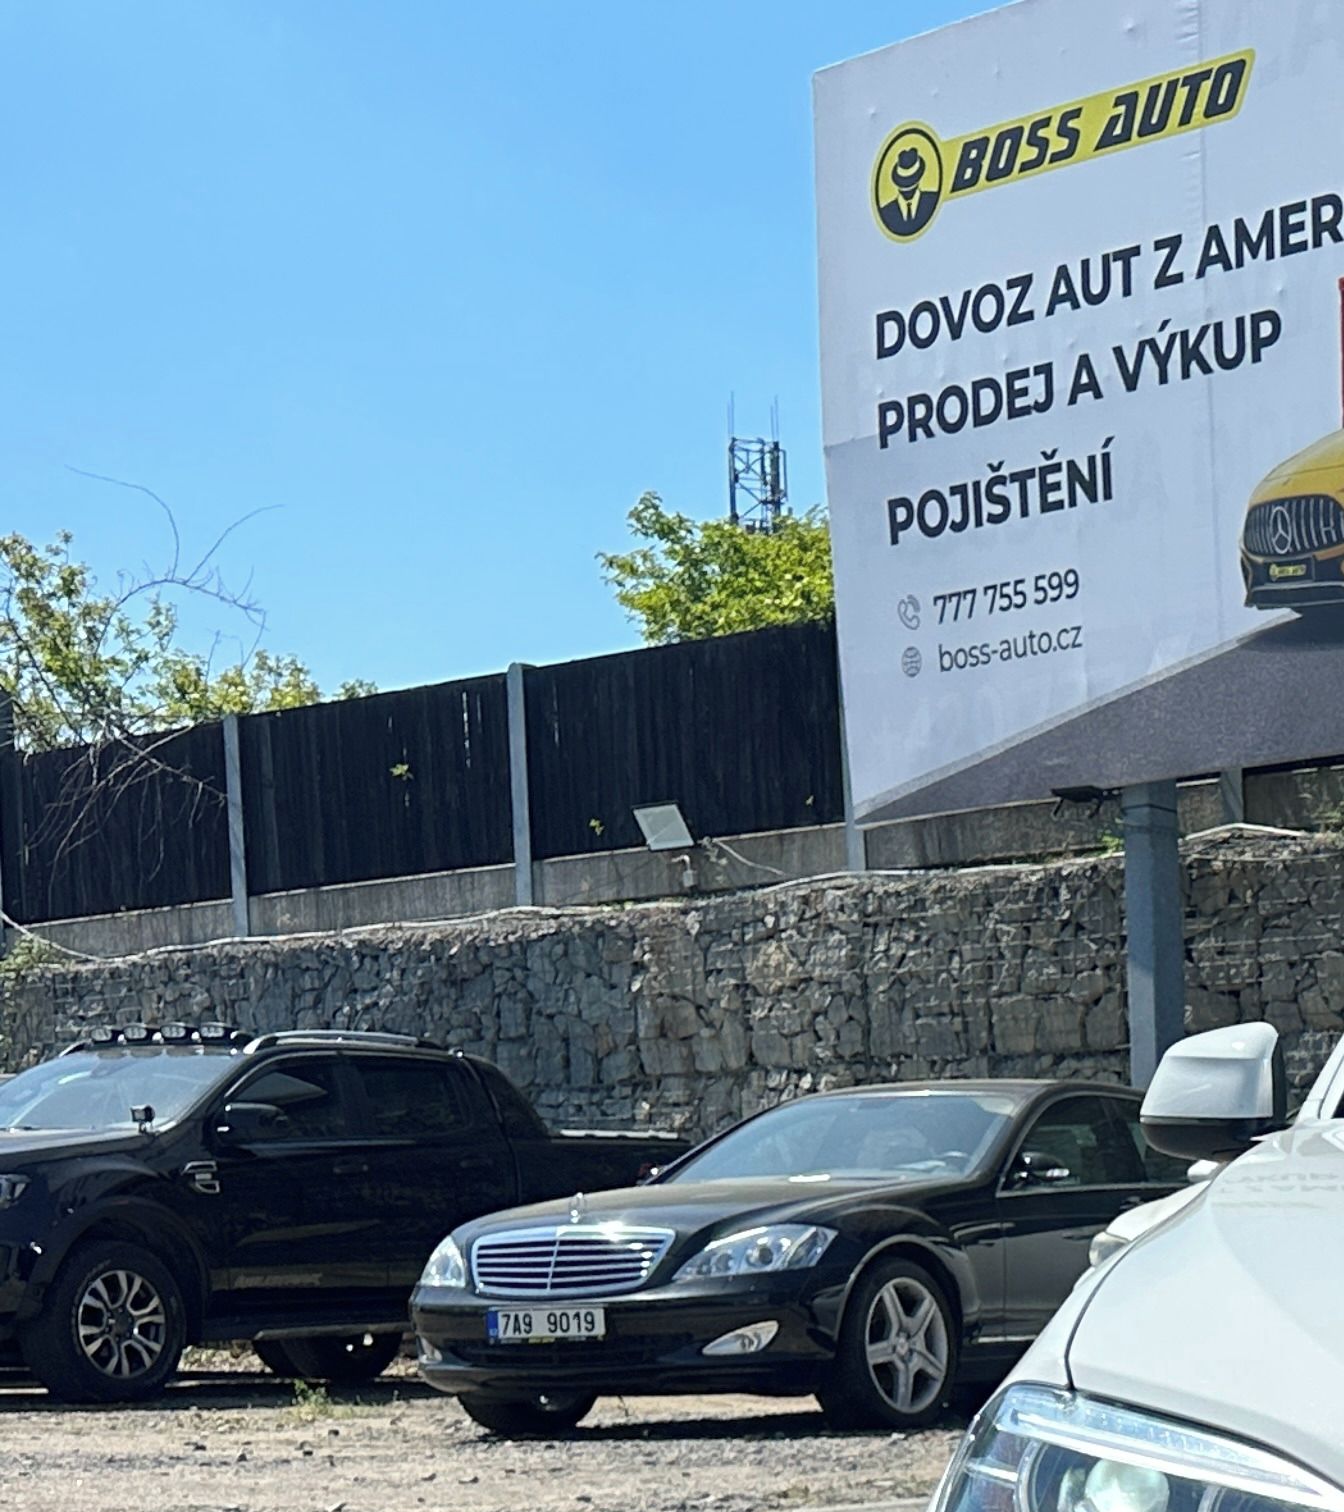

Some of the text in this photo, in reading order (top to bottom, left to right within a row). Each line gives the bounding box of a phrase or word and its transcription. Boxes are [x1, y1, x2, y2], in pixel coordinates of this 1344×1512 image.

[950, 58, 1247, 194] BOSS AUTO
[874, 273, 1035, 360] DOVOZ
[1045, 245, 1142, 318] AUT
[1153, 235, 1184, 290] Z
[877, 309, 1283, 449] PRODEJ A VÝKUP
[887, 437, 1115, 546] POJIŠTĚNÍ
[933, 568, 1080, 625] 777 755 599
[937, 624, 1083, 673] boss-auto.cz
[501, 1311, 595, 1336] 7A9 9019
